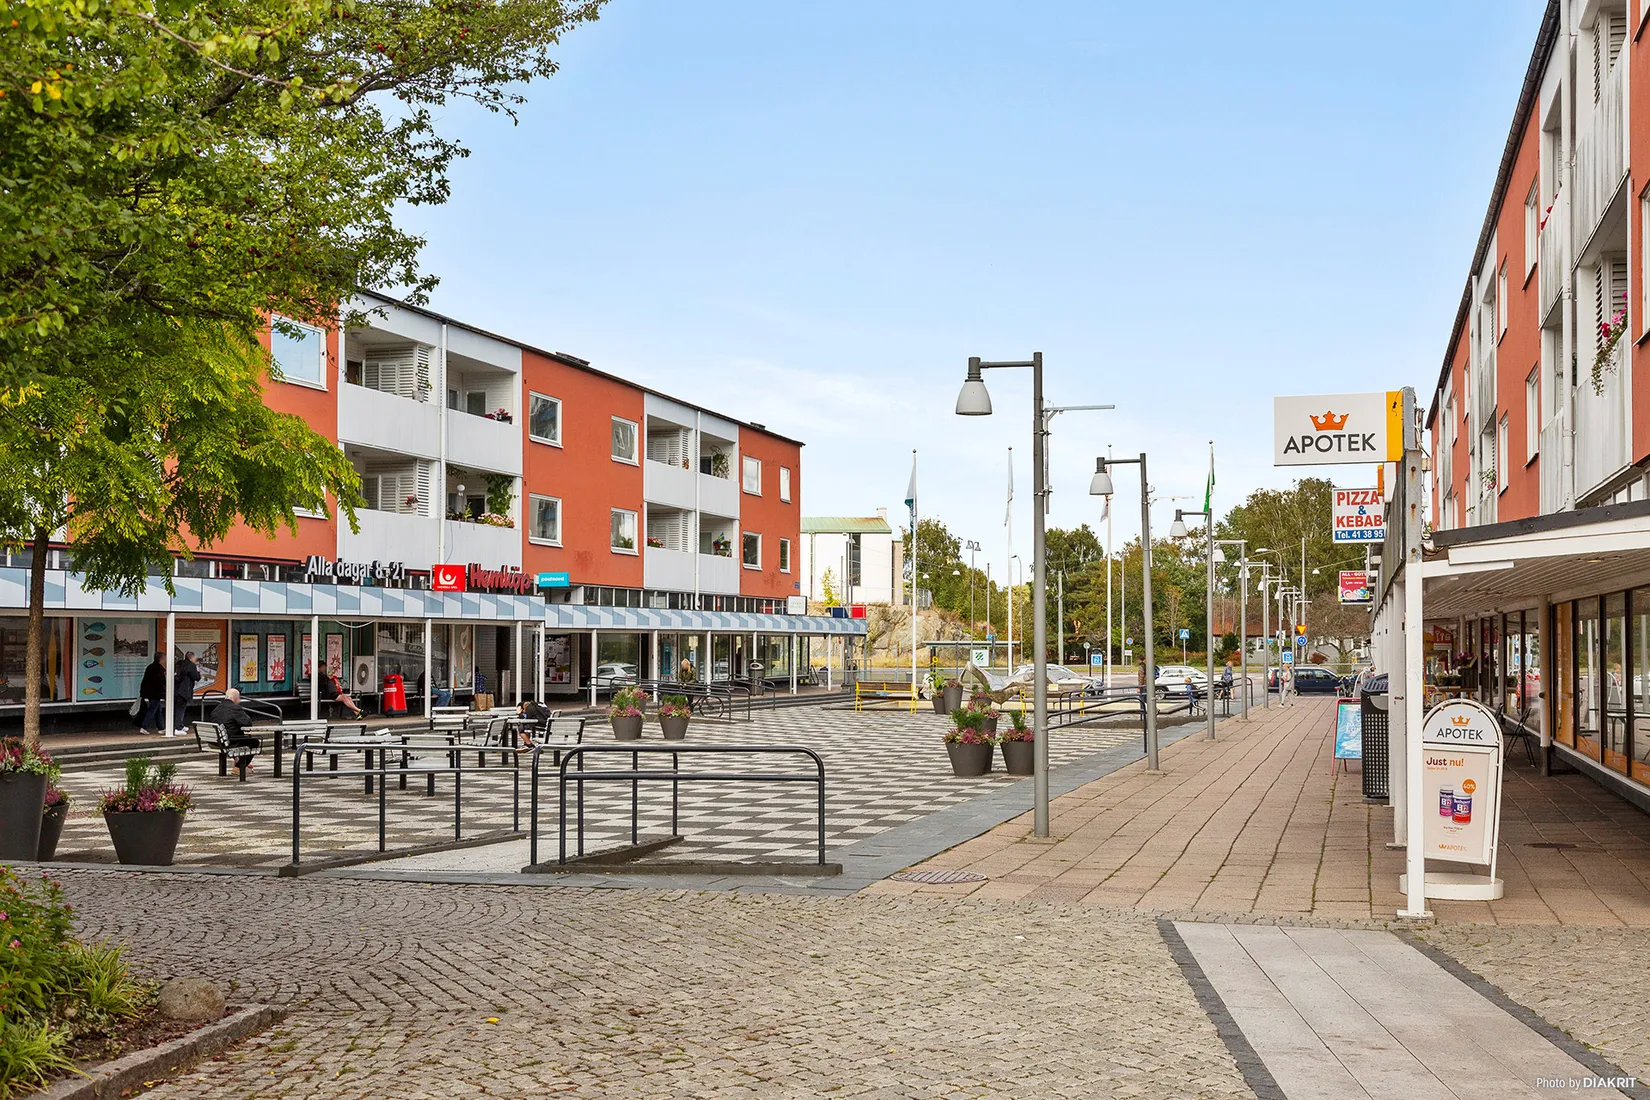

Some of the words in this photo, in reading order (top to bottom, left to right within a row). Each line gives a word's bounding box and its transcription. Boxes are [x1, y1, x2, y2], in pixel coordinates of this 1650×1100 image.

[1283, 433, 1376, 454] APOTEK
[1337, 491, 1380, 506] PIZZA
[1358, 505, 1366, 515] &
[1336, 515, 1383, 528] KEBAB
[1337, 531, 1350, 539] Tel.
[1374, 530, 1383, 538] 95
[307, 556, 332, 576] Alla
[336, 560, 373, 582] dagar
[468, 563, 530, 594] Hemköp
[1436, 728, 1483, 740] APOTEK
[1426, 757, 1447, 766] Just
[1449, 758, 1464, 767] nu!
